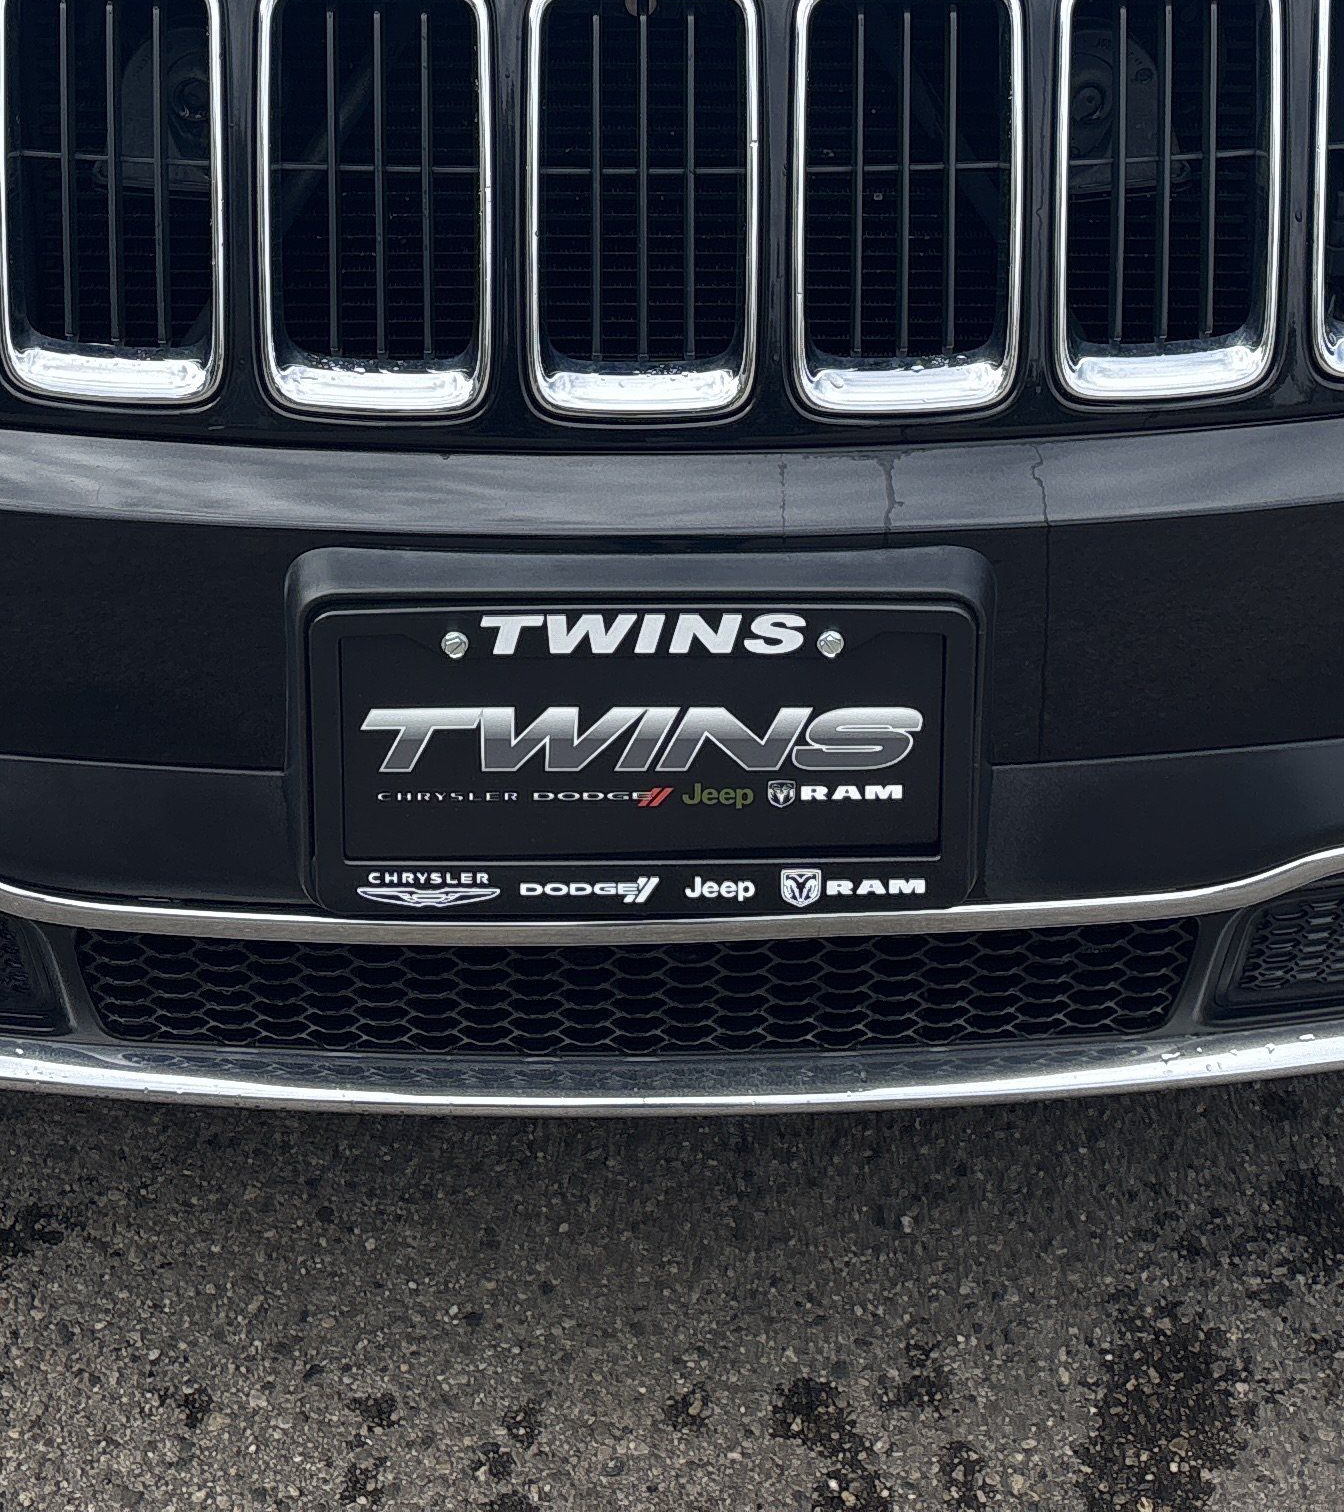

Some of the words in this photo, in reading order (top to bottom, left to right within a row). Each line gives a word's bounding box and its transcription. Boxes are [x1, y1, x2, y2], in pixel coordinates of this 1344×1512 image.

[479, 613, 807, 655] TWINS
[360, 706, 924, 773] TWINS
[376, 791, 518, 802] CHRYSLER
[532, 791, 654, 802] DODGE
[682, 783, 754, 809] Jeep
[800, 784, 903, 801] RAM
[367, 871, 490, 885] CHRYSLER
[519, 882, 640, 897] DODGE
[684, 876, 756, 902] Jeep
[825, 877, 927, 896] RAM
